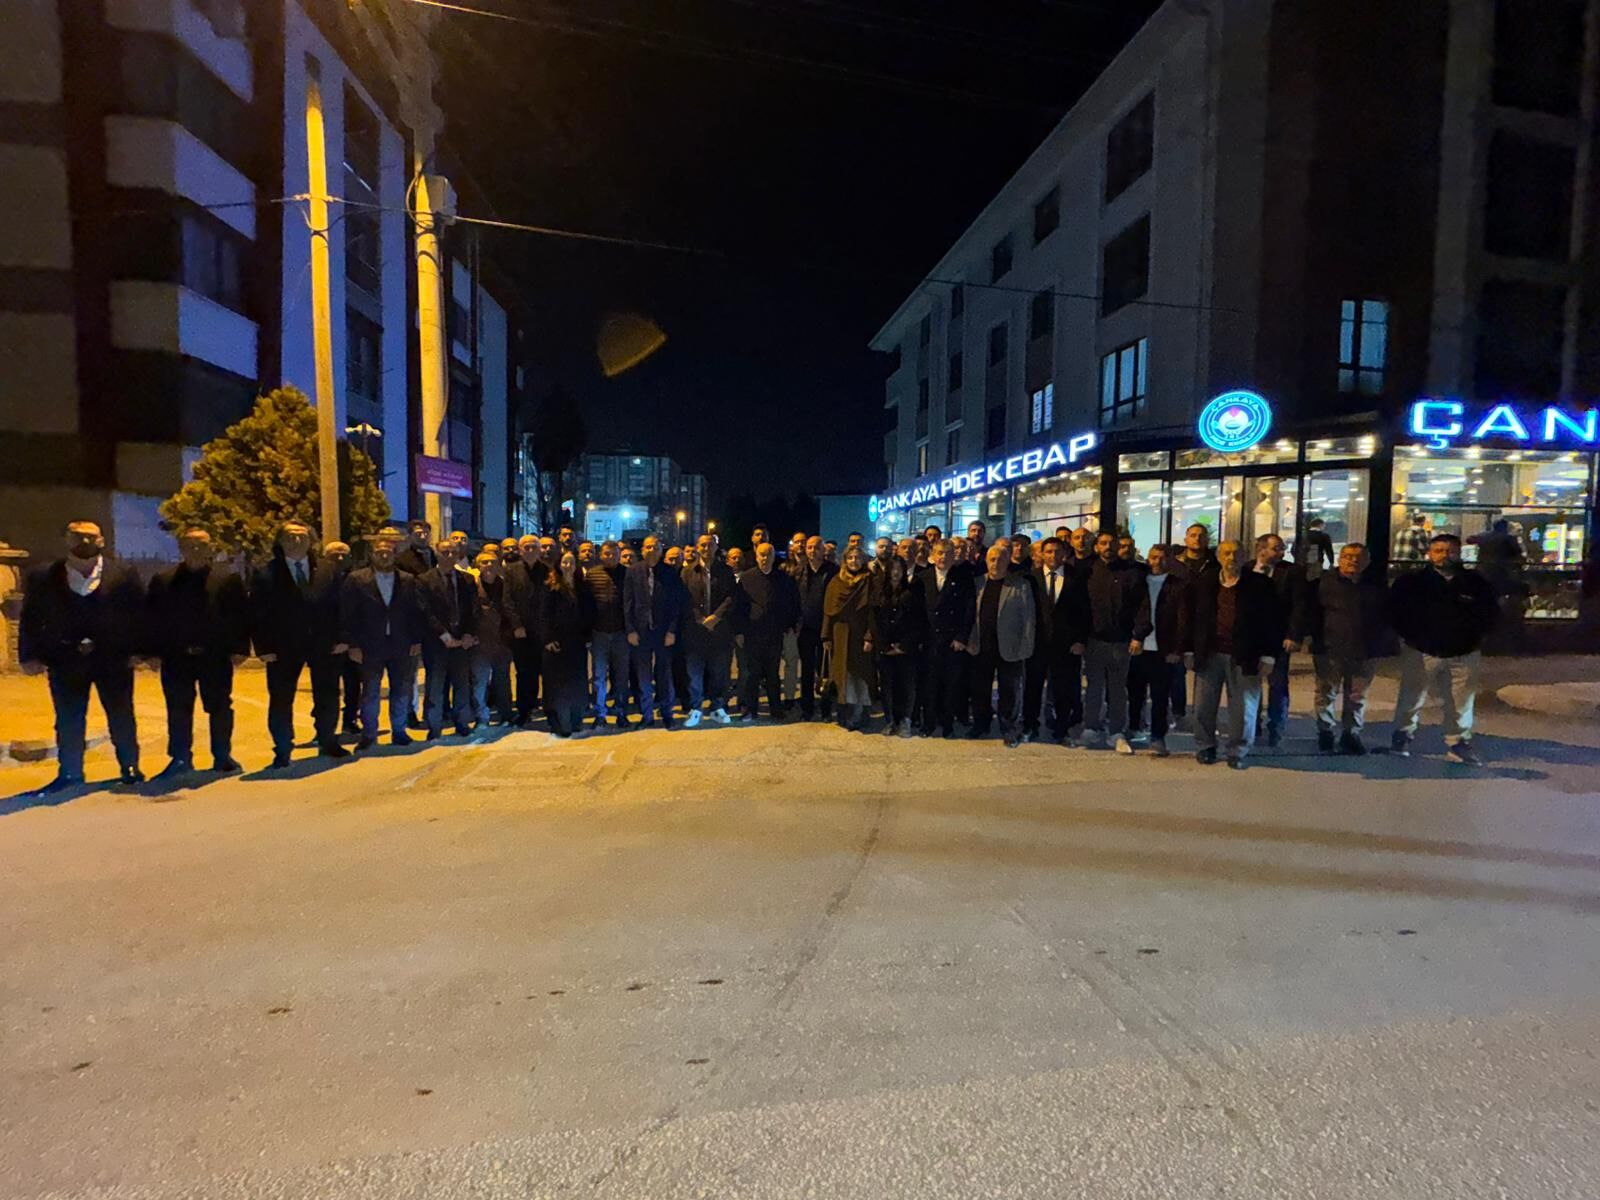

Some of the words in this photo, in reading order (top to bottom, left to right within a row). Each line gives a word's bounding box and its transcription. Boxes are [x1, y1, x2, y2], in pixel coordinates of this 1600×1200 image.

[1412, 401, 1598, 449] ÇAN
[877, 483, 940, 518] ÇANKAYA
[941, 470, 985, 497] PİDE
[987, 432, 1096, 484] KEBAP
